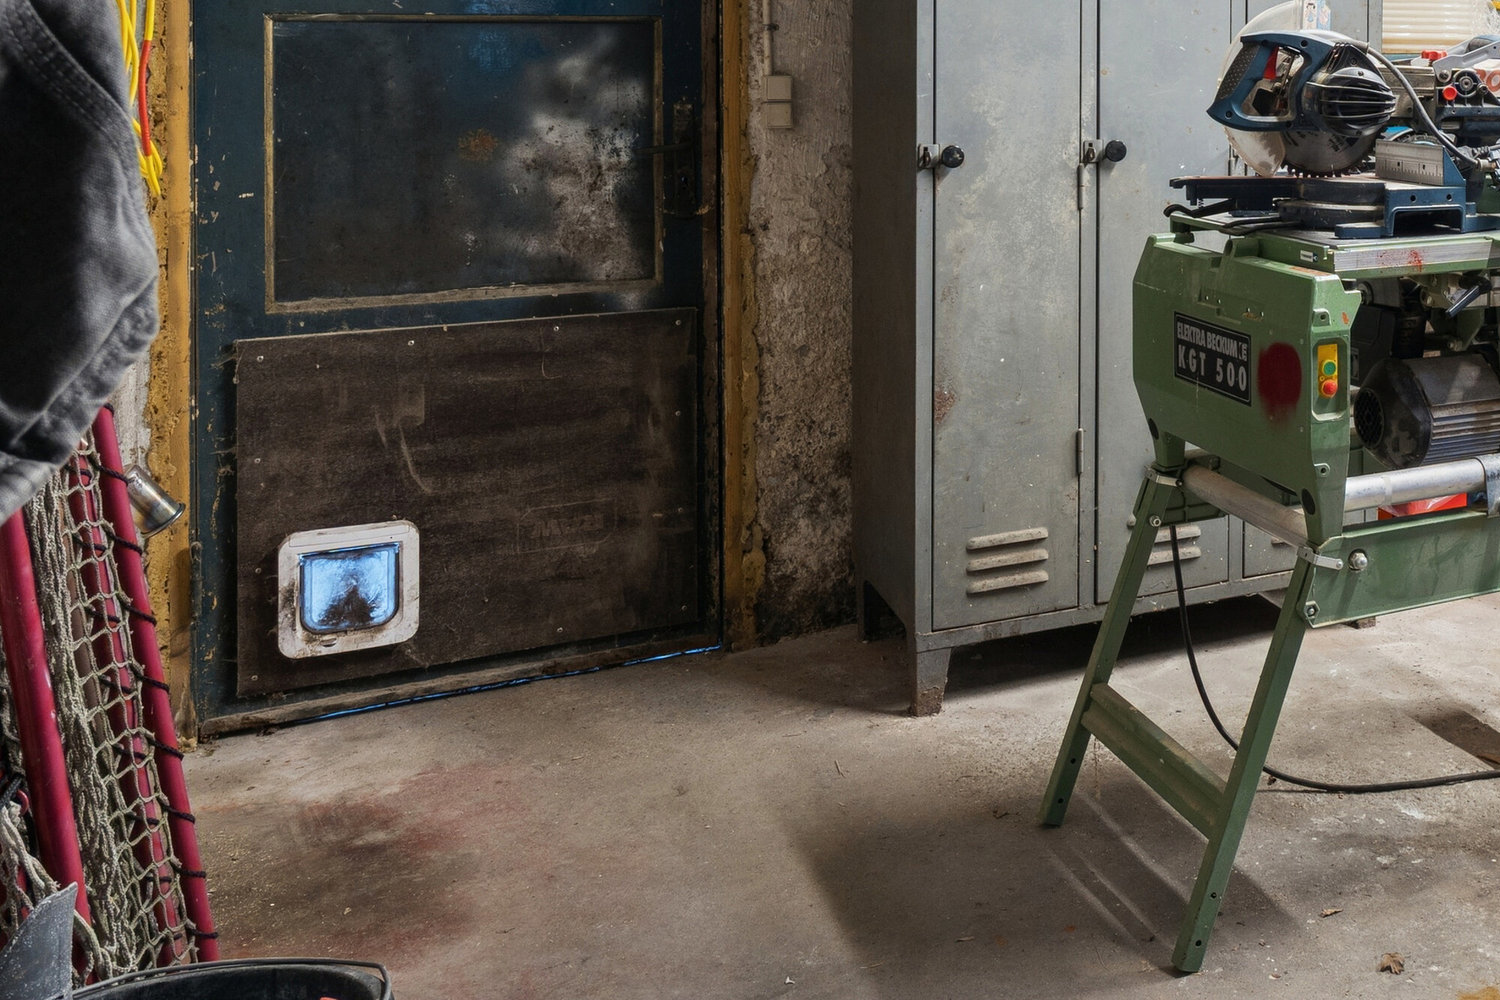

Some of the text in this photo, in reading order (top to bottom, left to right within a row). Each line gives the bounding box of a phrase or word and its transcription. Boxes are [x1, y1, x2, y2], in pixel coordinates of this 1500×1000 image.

[1177, 321, 1206, 347] ELEKTRA
[1206, 331, 1238, 358] BECKUM
[1216, 358, 1247, 391] 500
